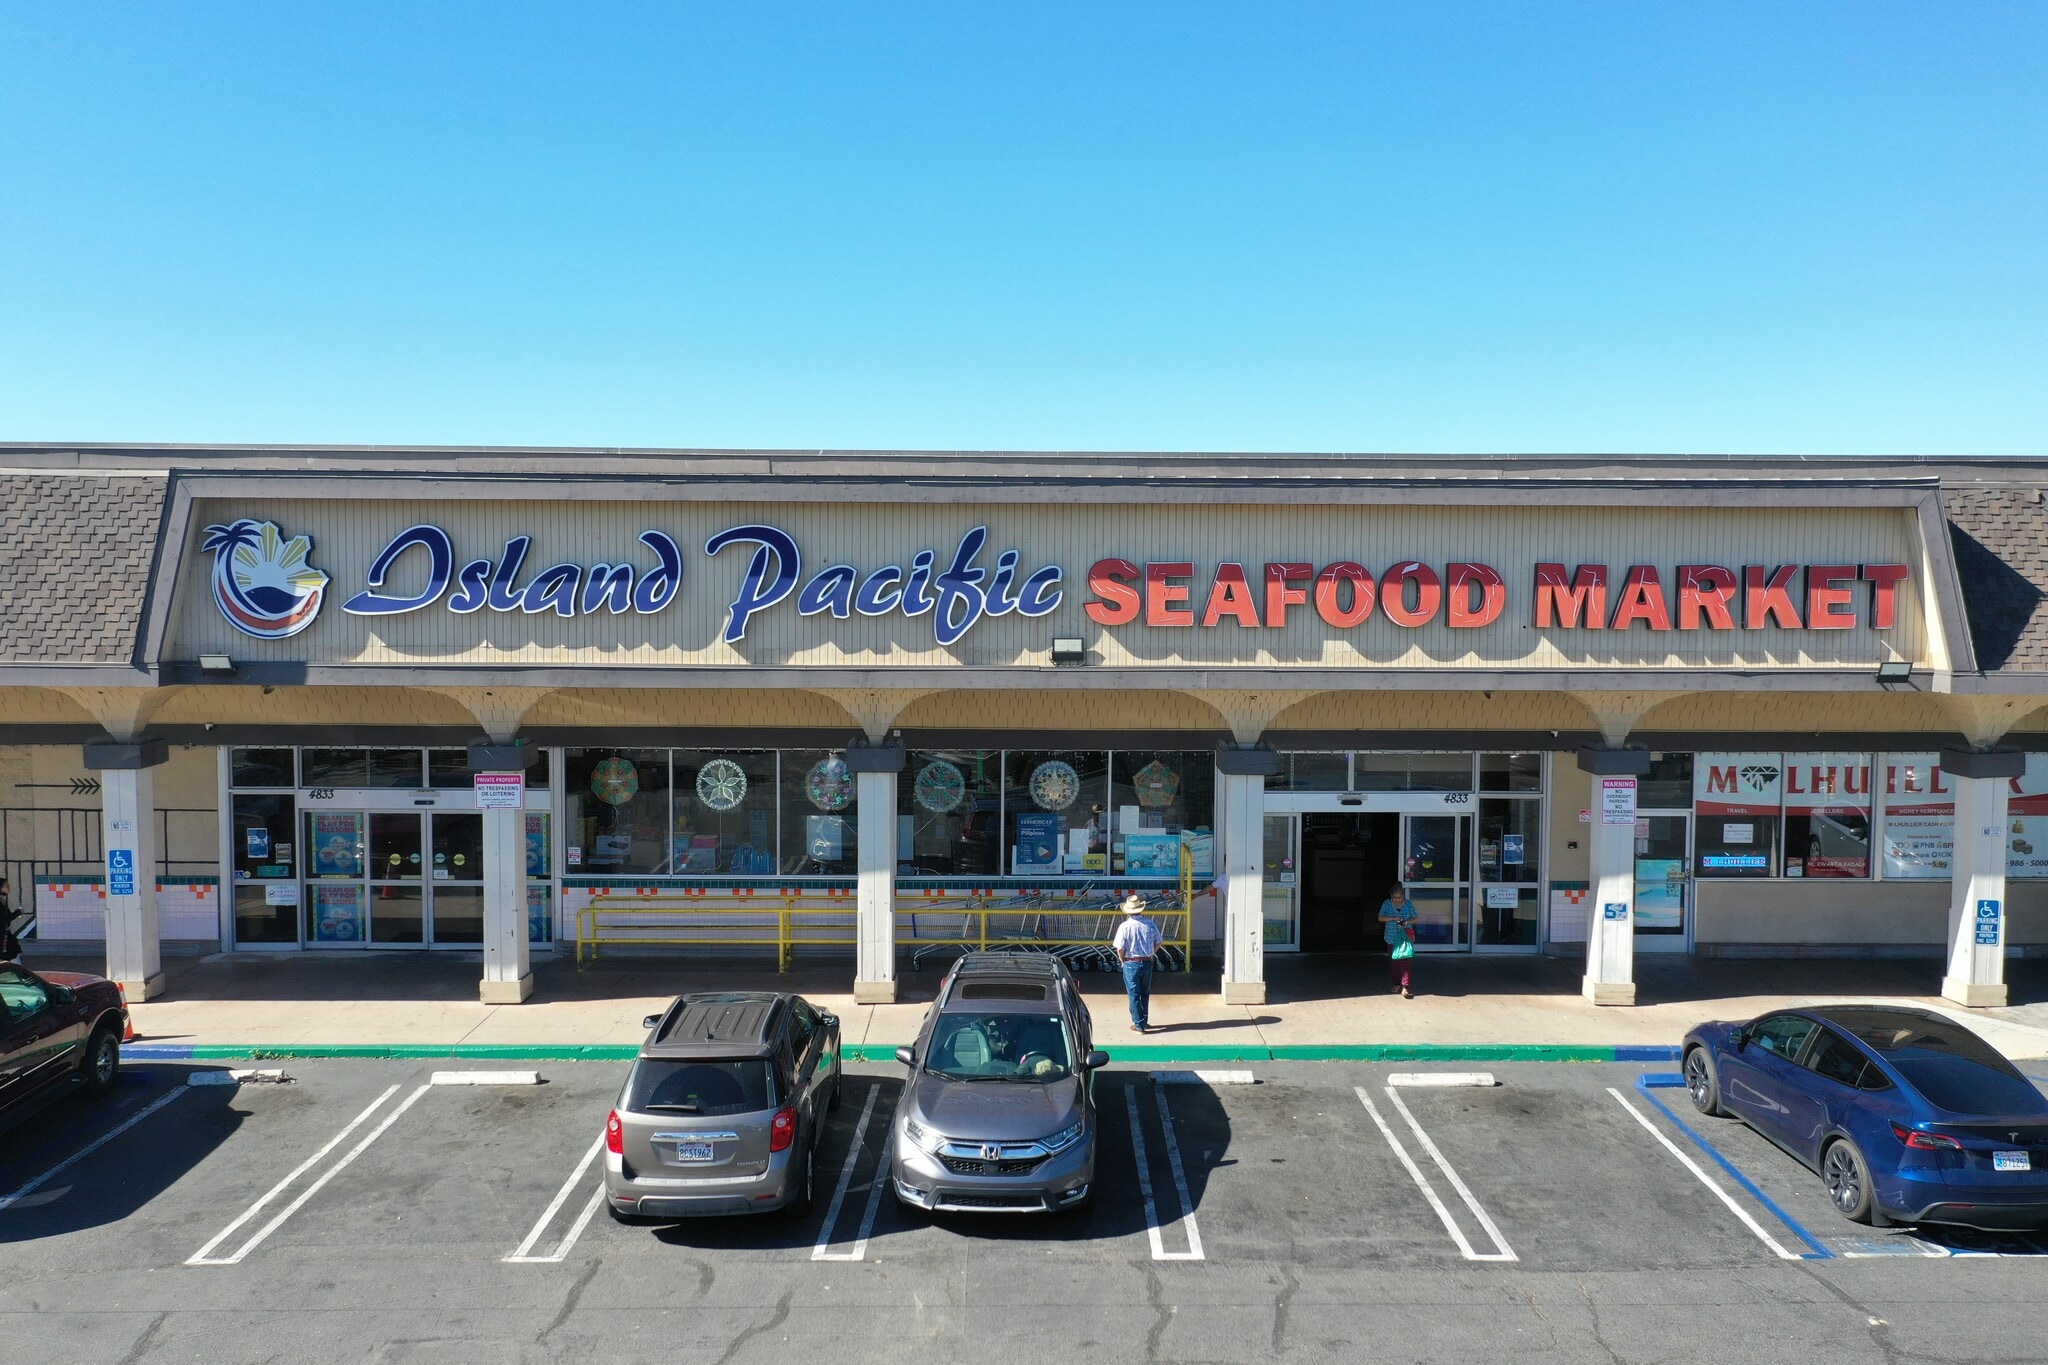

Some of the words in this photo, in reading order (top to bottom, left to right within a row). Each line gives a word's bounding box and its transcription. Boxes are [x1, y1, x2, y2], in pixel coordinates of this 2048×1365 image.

[341, 524, 684, 618] Island
[704, 524, 1063, 647] Pacific
[1082, 558, 1507, 629] SEAFOOD
[1533, 563, 1909, 631] MARKET
[1706, 766, 1739, 793] M
[309, 789, 334, 799] 4833
[1443, 793, 1469, 803] 4833
[1980, 924, 1993, 932] ONLY
